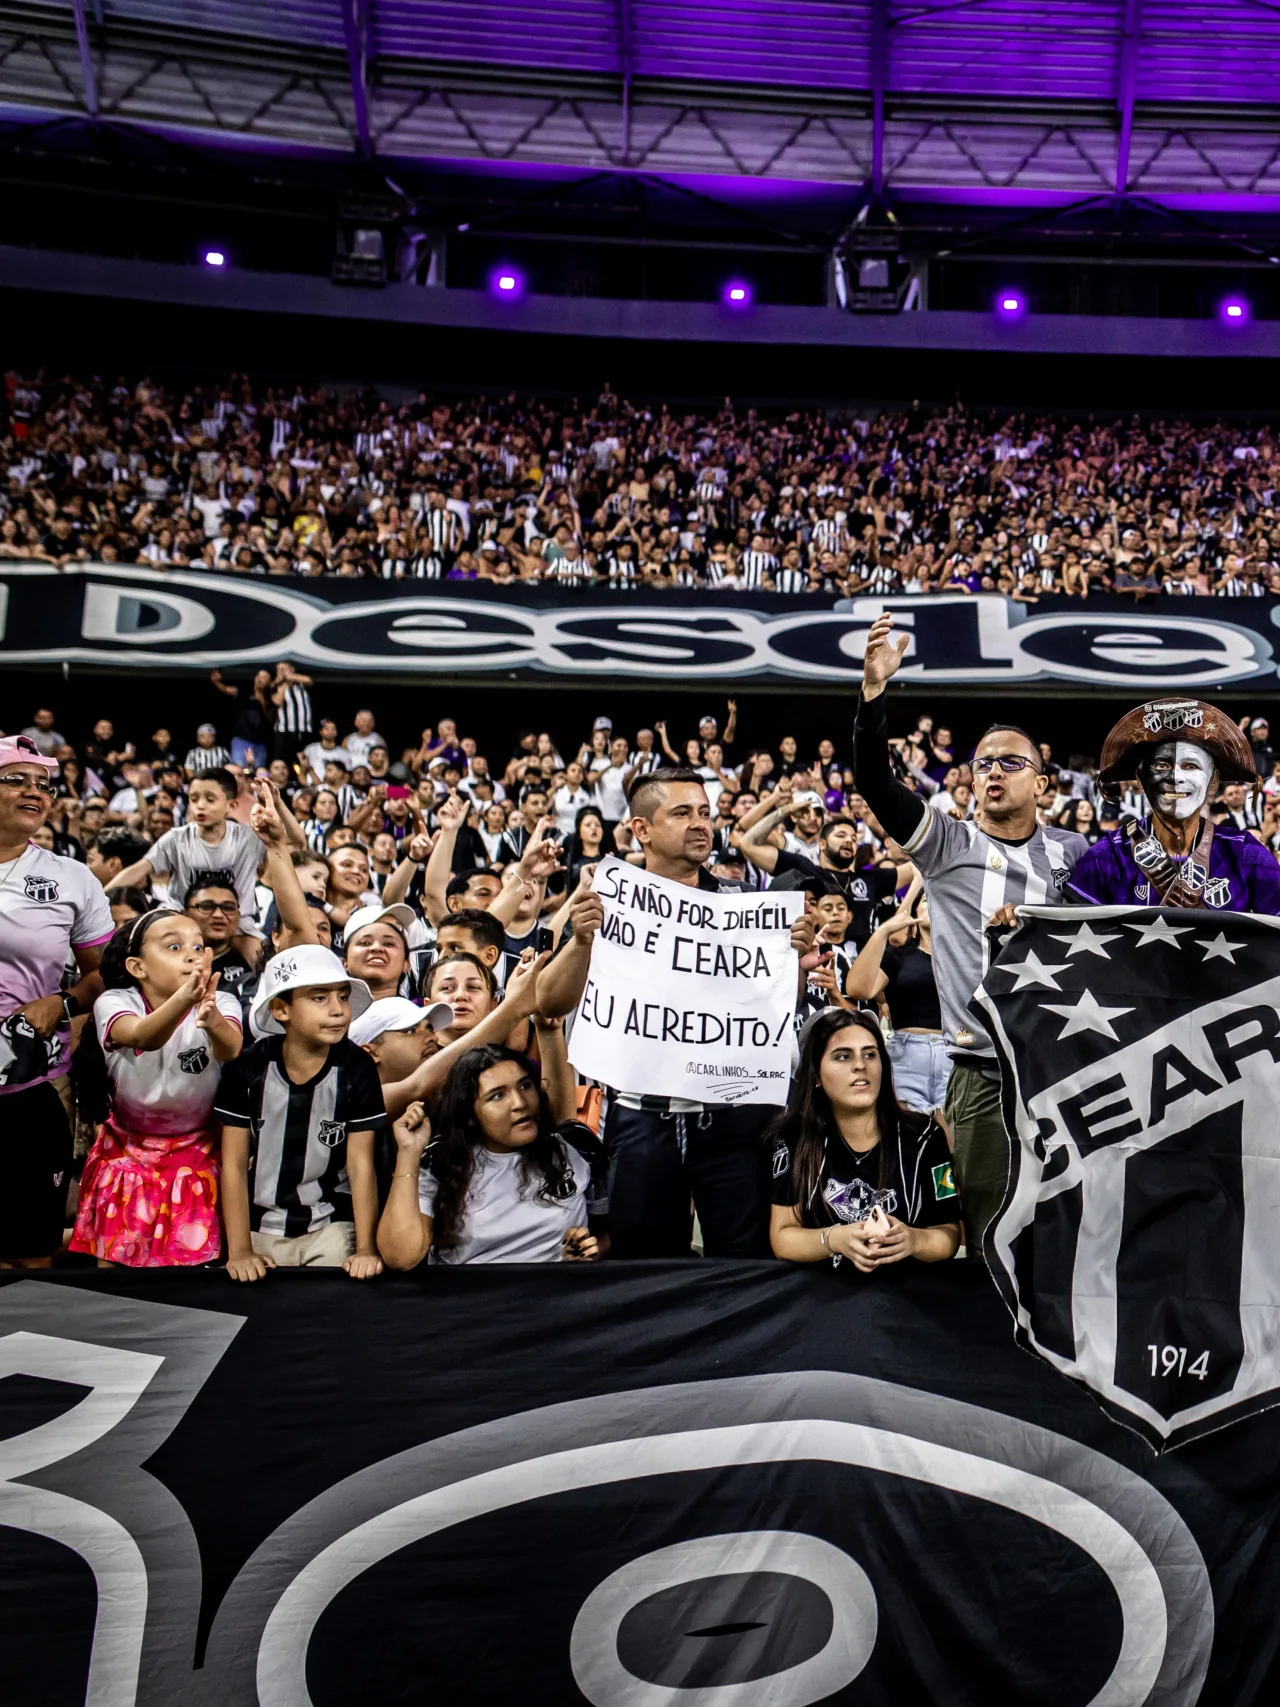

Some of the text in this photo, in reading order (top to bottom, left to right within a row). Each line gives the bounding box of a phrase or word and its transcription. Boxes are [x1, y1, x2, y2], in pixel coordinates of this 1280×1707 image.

[0, 562, 1278, 688] Desde
[597, 867, 629, 905] SE
[631, 883, 673, 919] NÃO
[677, 899, 719, 931] FOR
[643, 923, 662, 954] É
[672, 936, 771, 978] CEARA
[581, 979, 791, 1047] EU ACREDITO!
[1147, 1344, 1210, 1381] 1914
